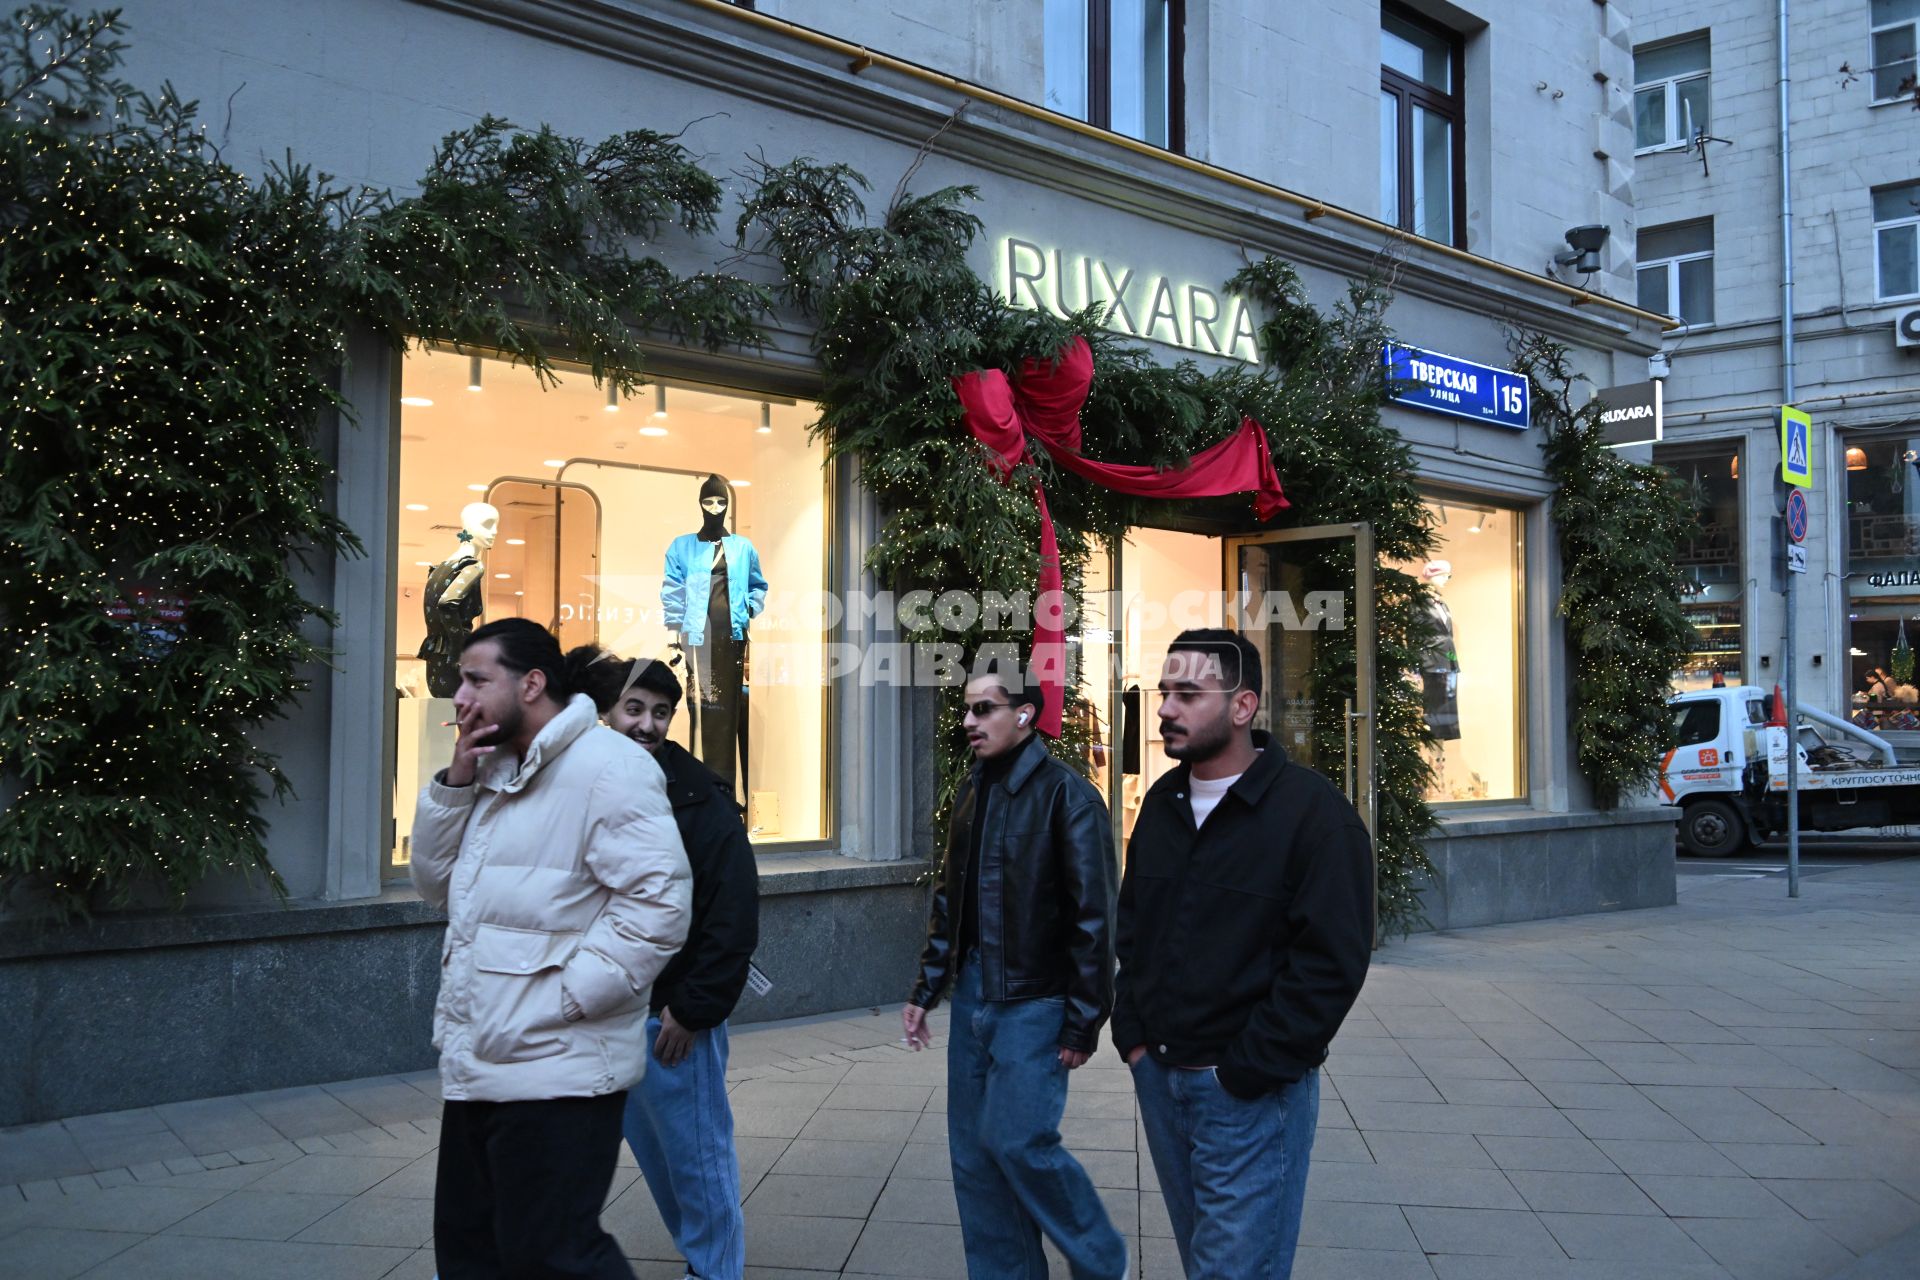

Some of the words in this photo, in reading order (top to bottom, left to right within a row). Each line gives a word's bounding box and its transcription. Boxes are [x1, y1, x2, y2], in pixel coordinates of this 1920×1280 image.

[1007, 237, 1260, 363] RUXARA
[1410, 359, 1478, 394] ТВЕРСКАЯ
[1430, 388, 1460, 404] УЛИЦА
[1501, 385, 1523, 414] 15
